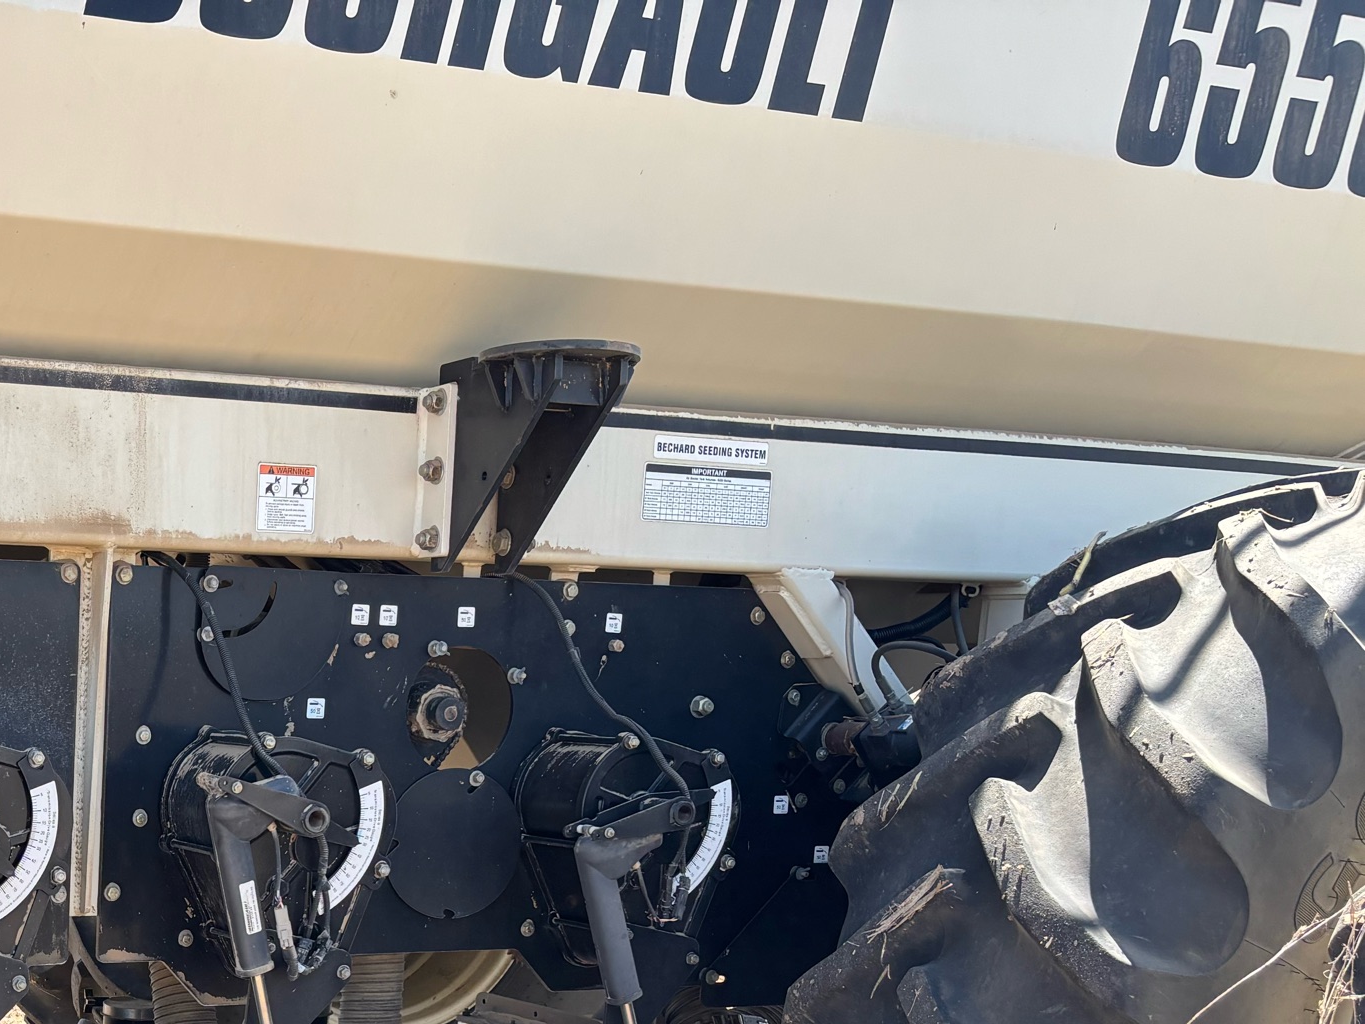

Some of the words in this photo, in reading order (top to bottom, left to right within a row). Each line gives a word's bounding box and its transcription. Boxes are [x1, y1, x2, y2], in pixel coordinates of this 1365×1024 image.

[1115, 0, 1365, 198] 655
[657, 442, 695, 454] BECHARD
[698, 445, 732, 457] SEEDING
[735, 448, 766, 460] SYSTEM
[276, 467, 310, 475] WARNING
[691, 468, 728, 477] IMPORTANT
